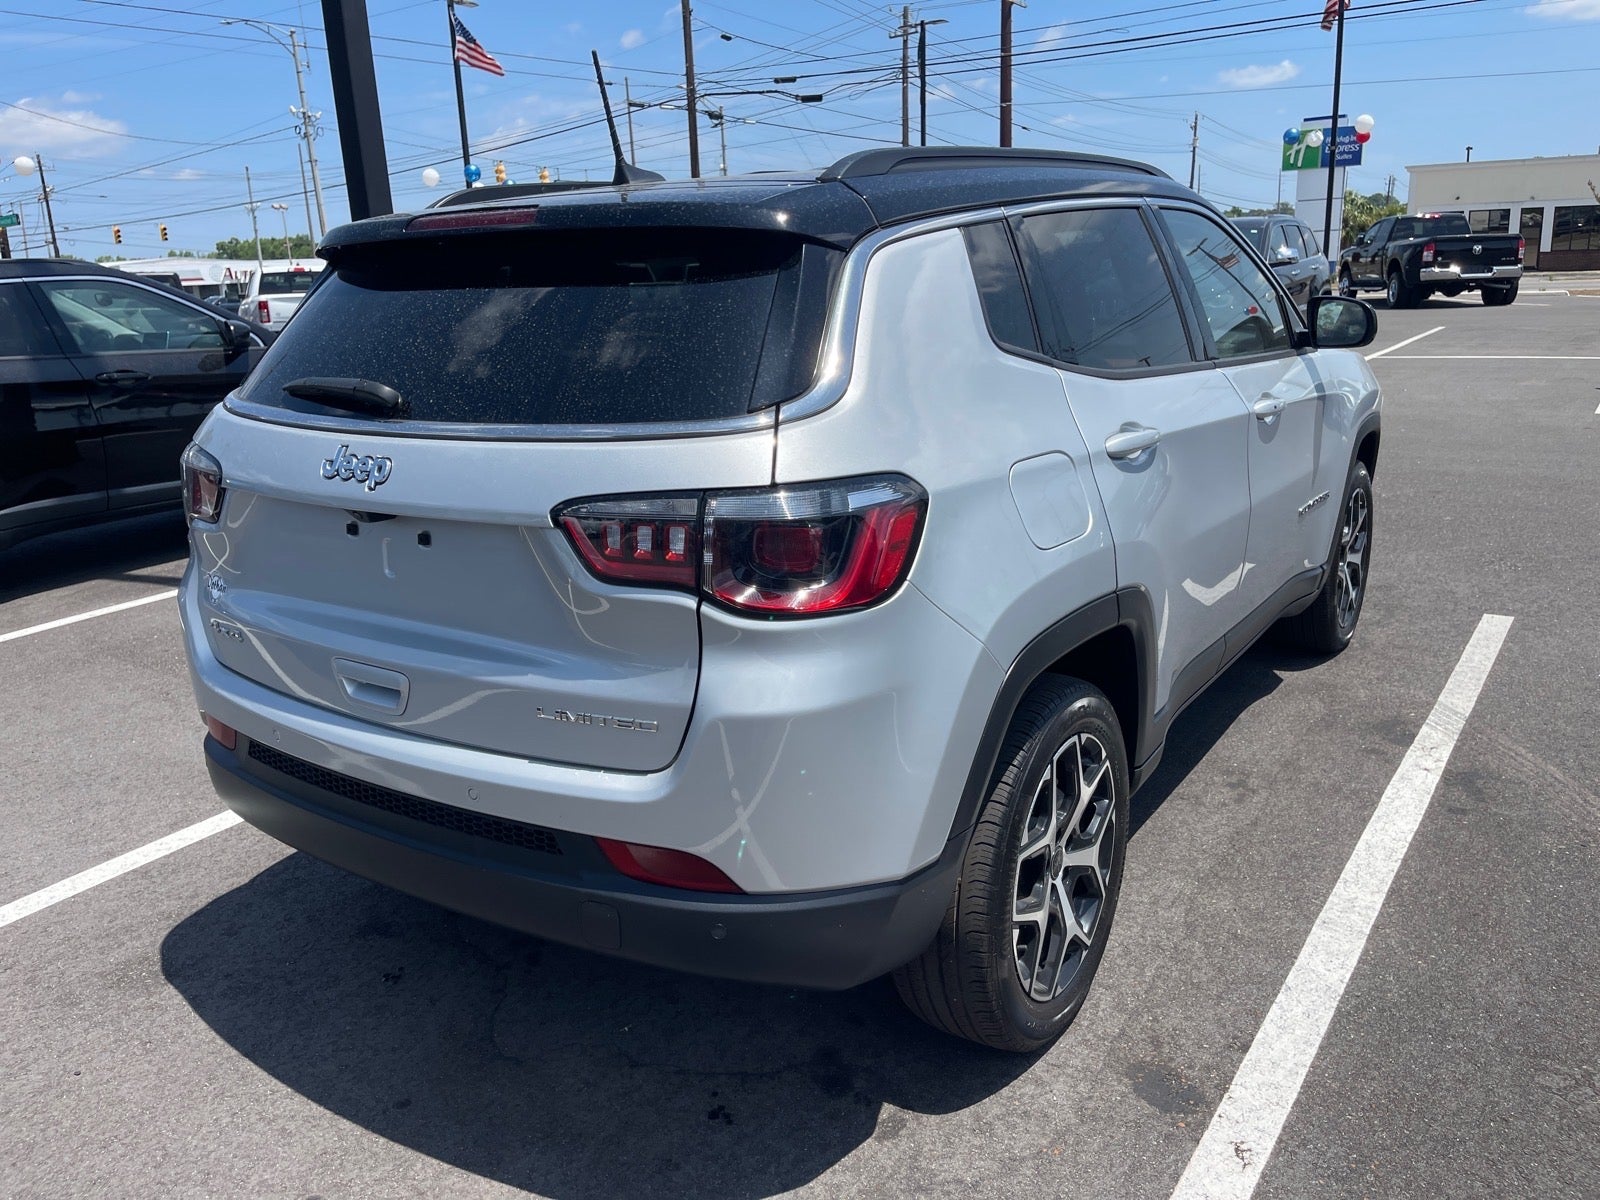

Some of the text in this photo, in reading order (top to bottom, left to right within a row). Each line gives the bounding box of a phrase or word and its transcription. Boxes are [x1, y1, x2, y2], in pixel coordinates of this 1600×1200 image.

[1325, 144, 1360, 153] Epress
[319, 444, 393, 492] Jeep
[536, 706, 660, 733] LIMITED
